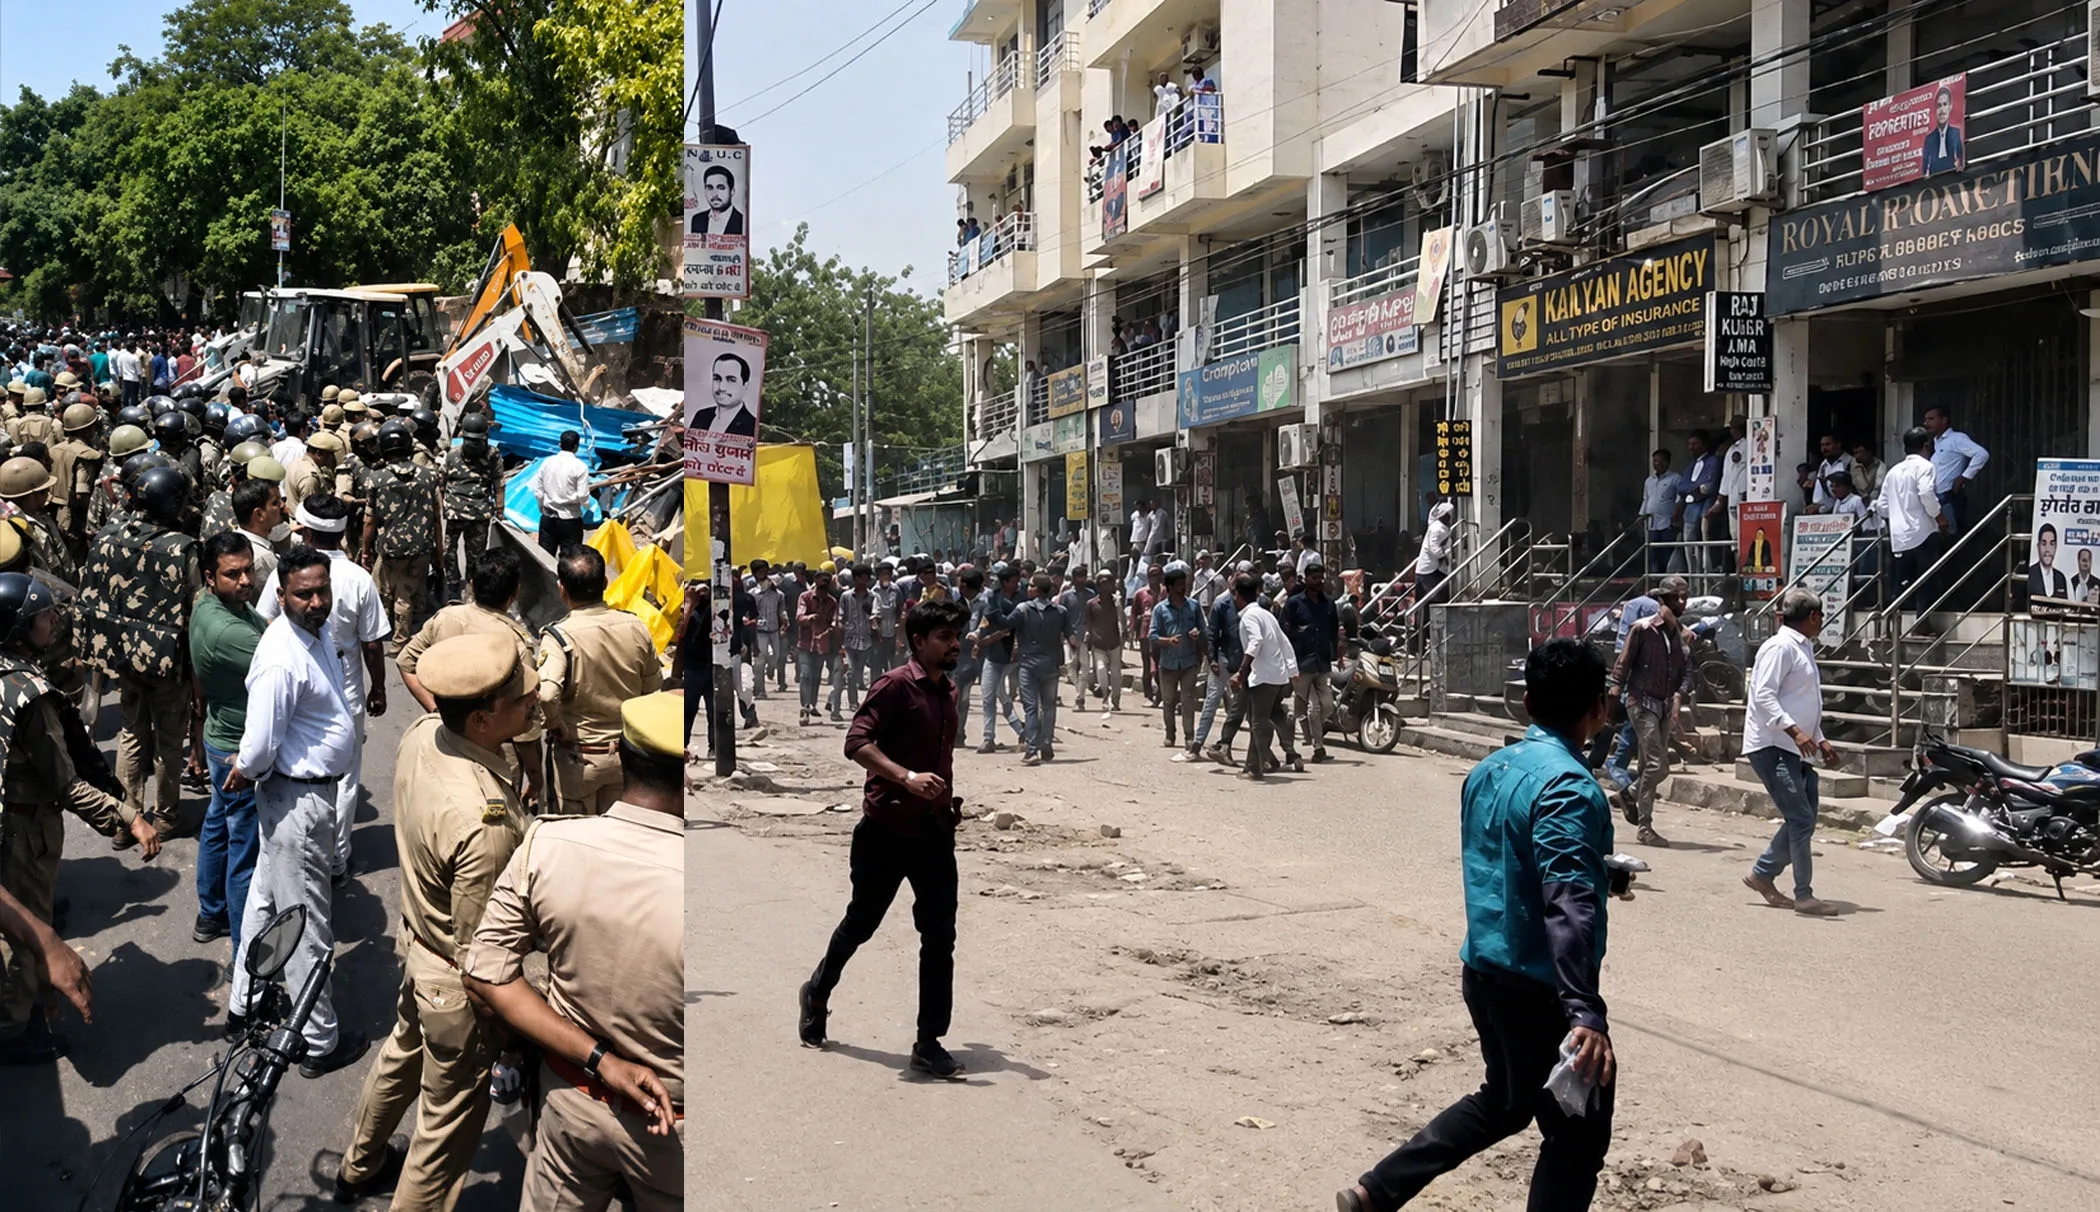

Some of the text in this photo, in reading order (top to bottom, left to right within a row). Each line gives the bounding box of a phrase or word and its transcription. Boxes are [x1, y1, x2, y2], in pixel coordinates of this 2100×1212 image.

[1781, 205, 1876, 255] ROYAL
[1626, 248, 1708, 305] AGENCY
[1546, 297, 1701, 346] ALL TYPE OF INSURANCE
[1731, 295, 1758, 318] RAJ
